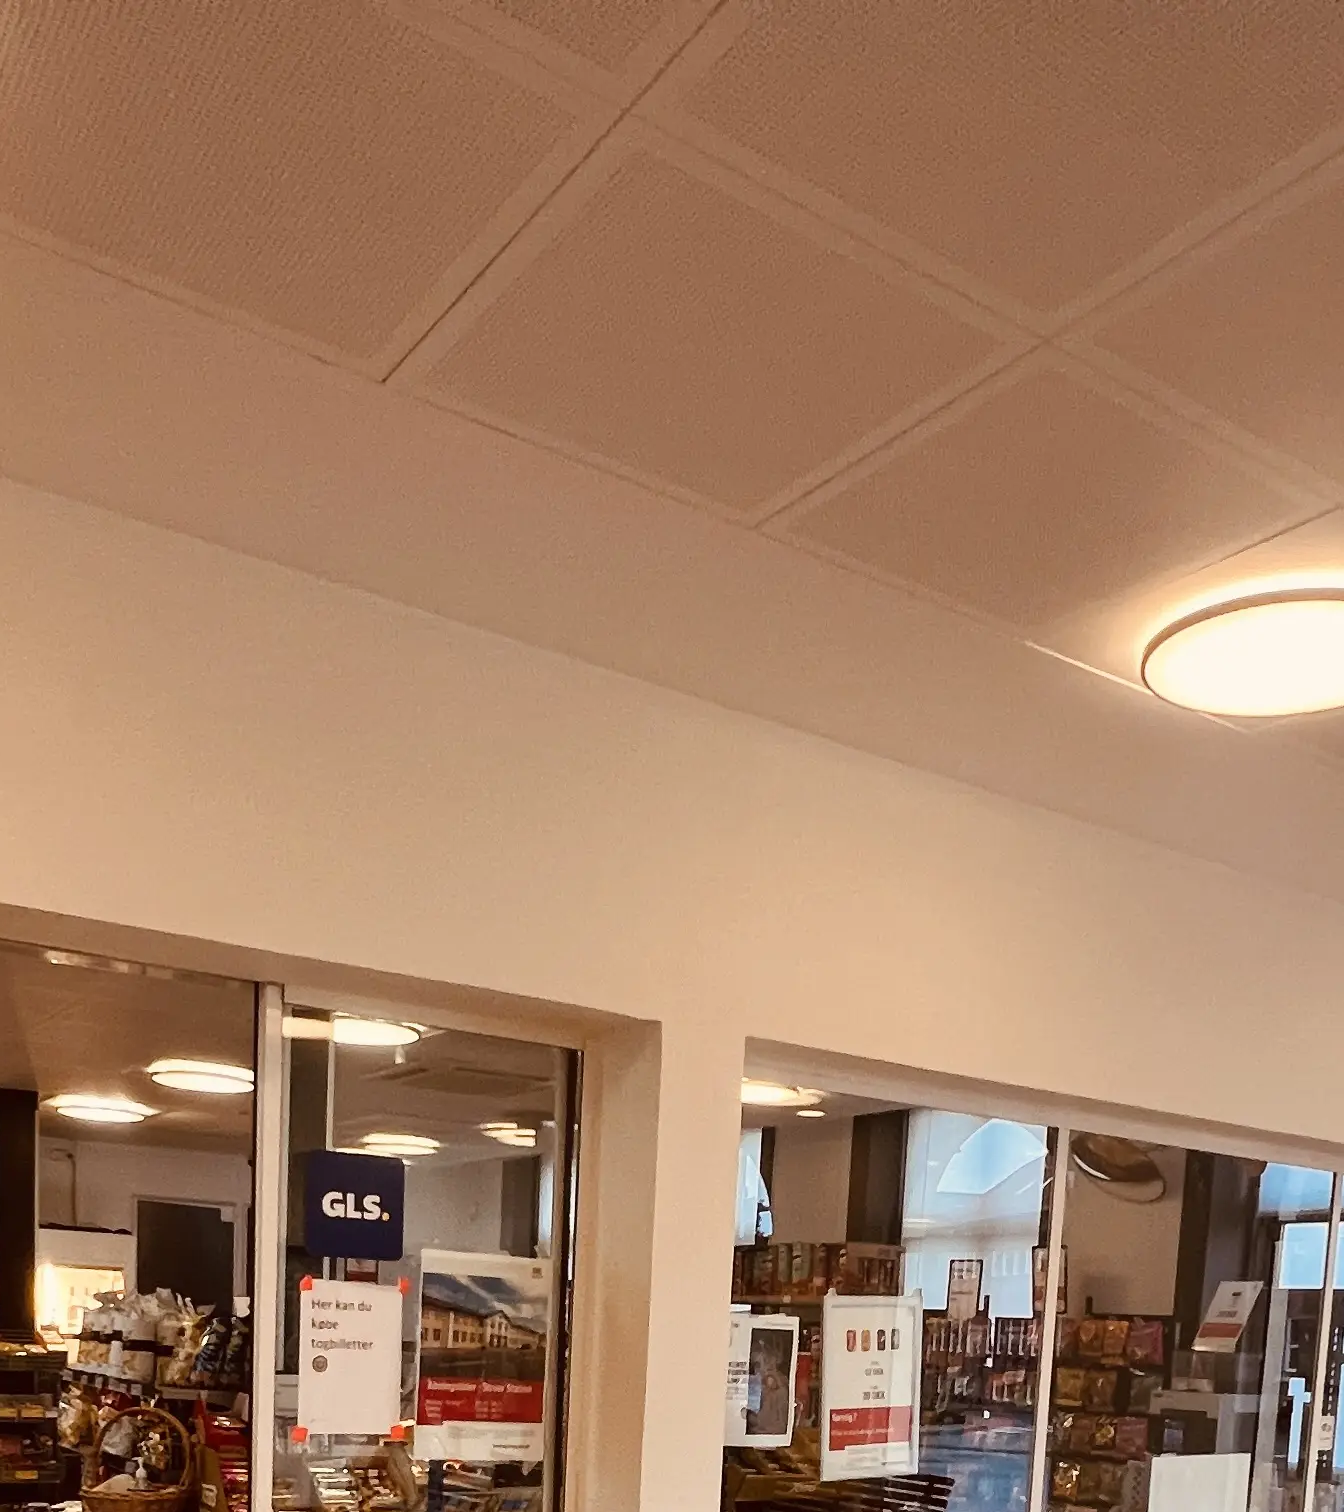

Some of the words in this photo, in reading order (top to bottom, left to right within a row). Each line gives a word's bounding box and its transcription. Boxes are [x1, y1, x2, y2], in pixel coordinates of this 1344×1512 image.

[322, 1191, 390, 1222] GLS.
[311, 1299, 333, 1310] Her
[335, 1299, 355, 1310] kan
[358, 1300, 372, 1312] du
[311, 1338, 374, 1351] togbilletter
